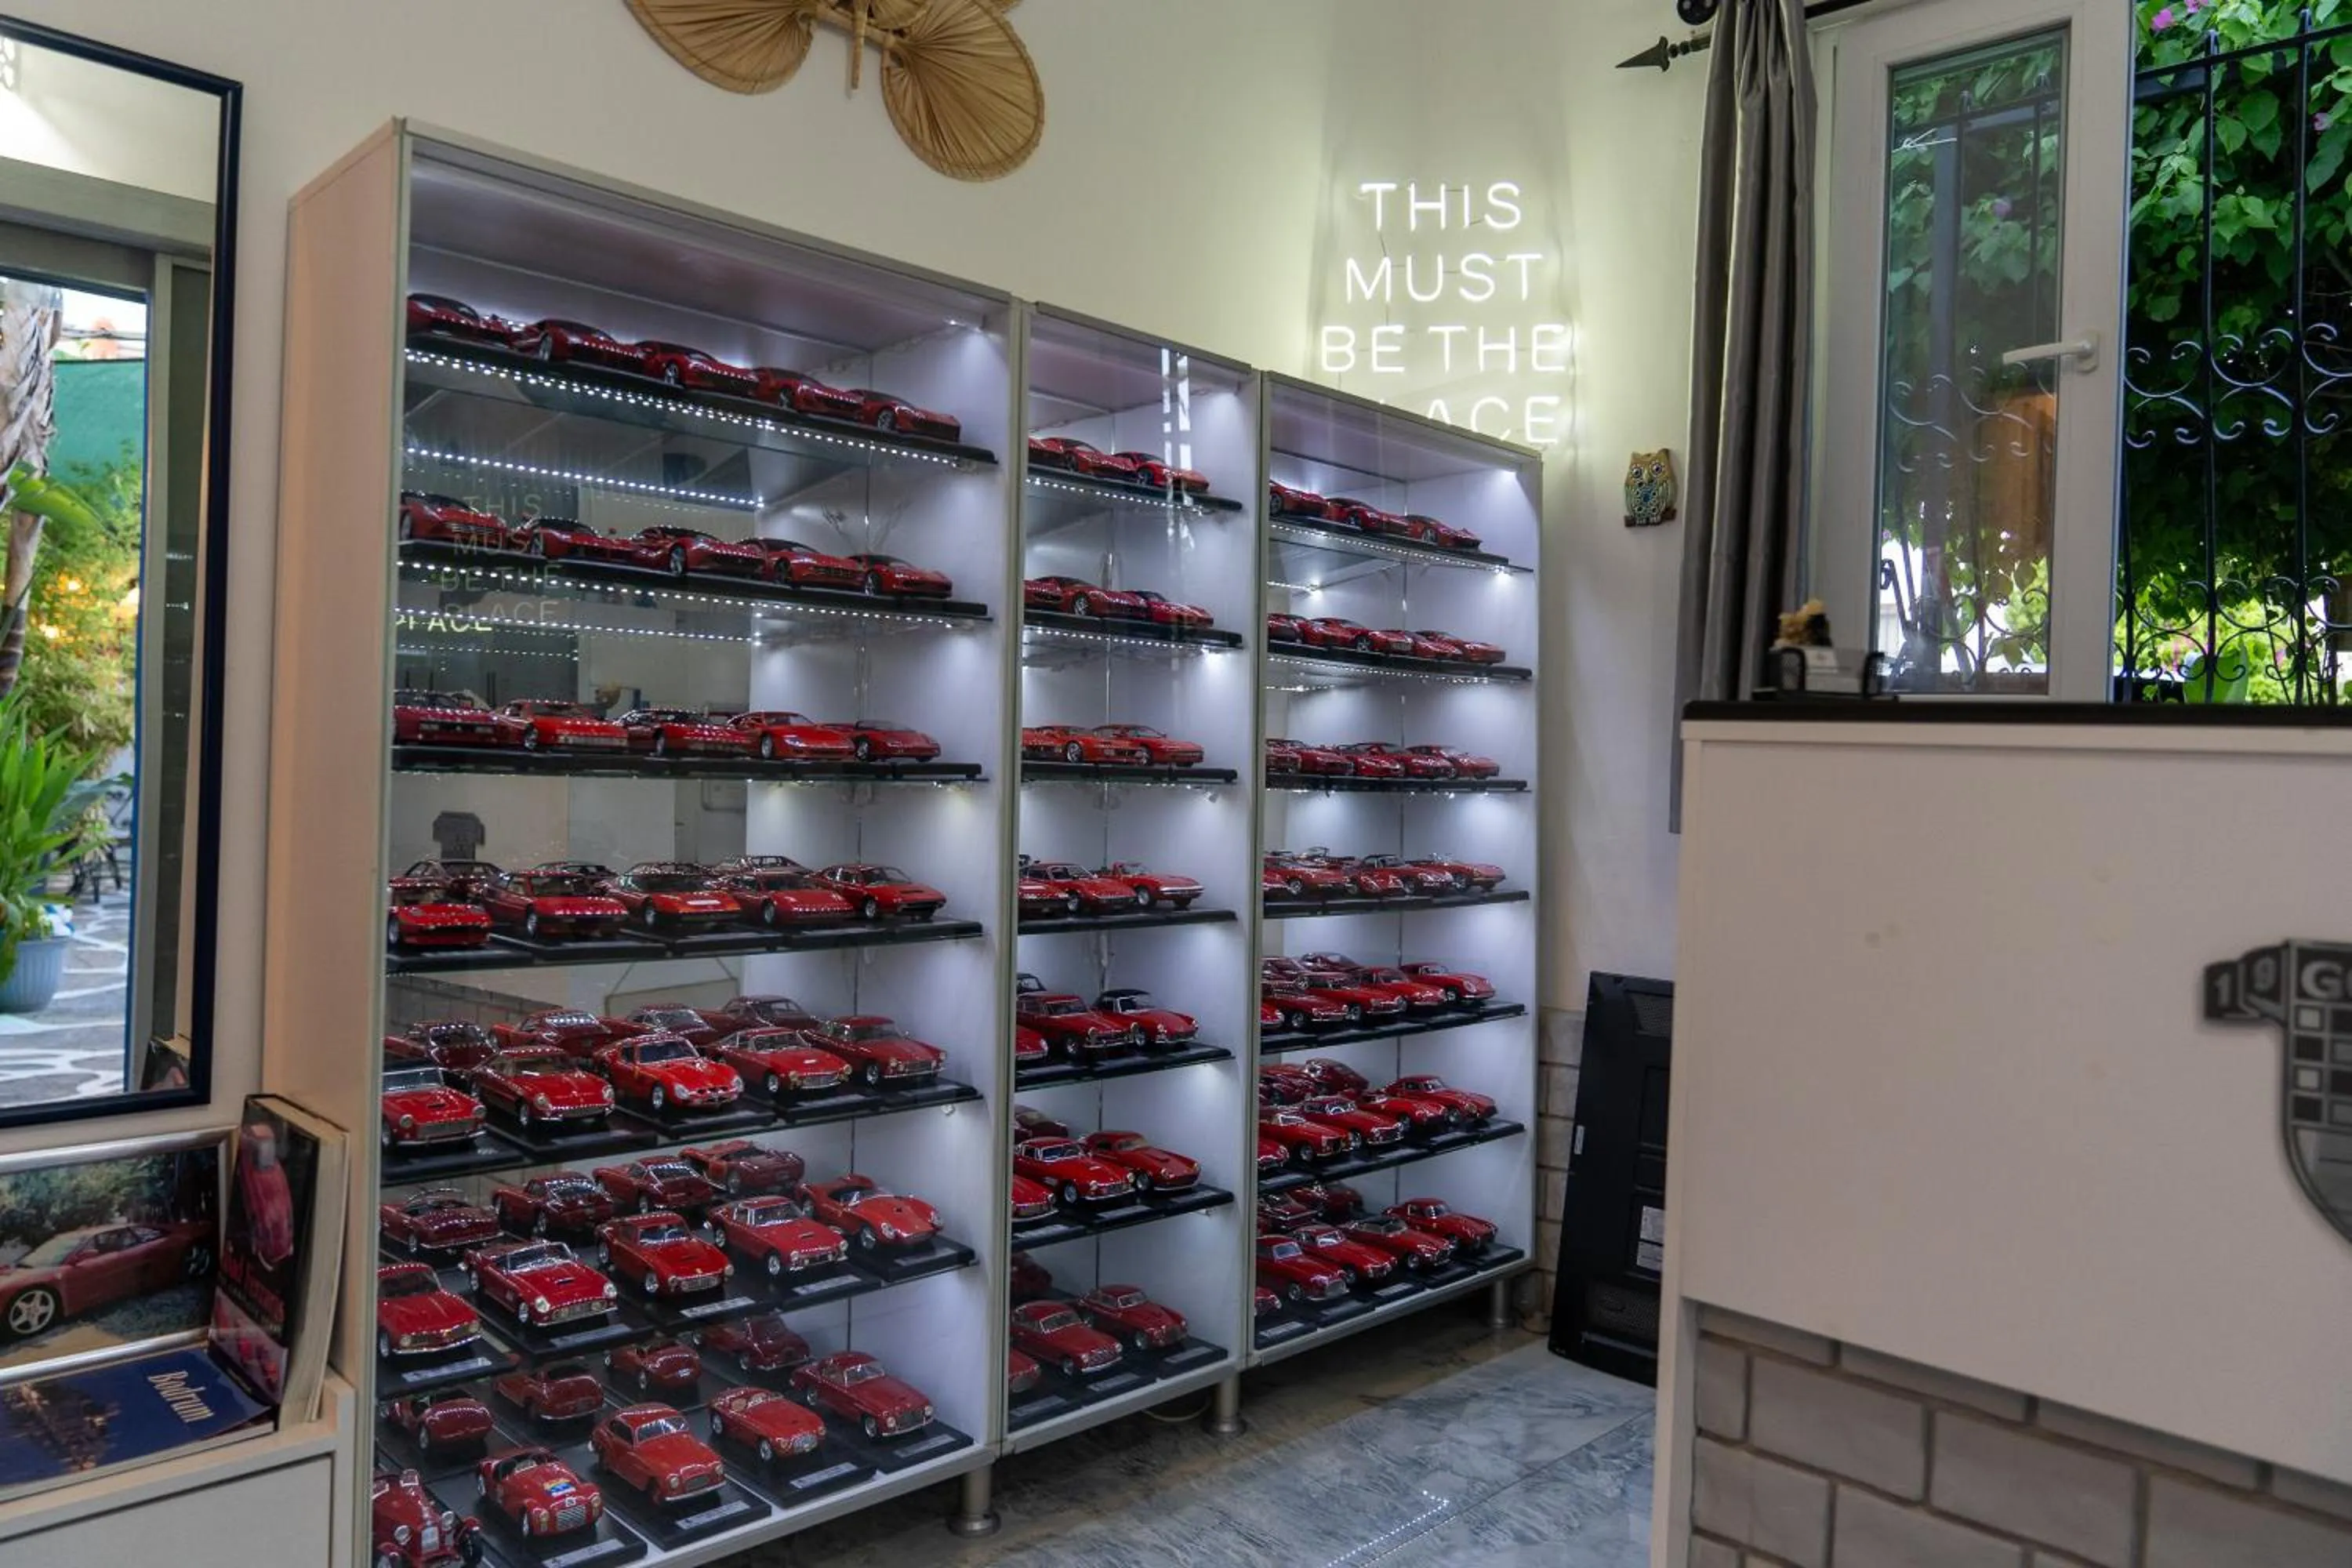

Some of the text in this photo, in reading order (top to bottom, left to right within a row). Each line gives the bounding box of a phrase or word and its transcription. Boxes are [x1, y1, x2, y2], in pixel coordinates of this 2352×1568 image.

[1359, 182, 1522, 231] THIS
[1345, 252, 1544, 303] MUST
[1320, 323, 1567, 375] BE THE
[1378, 396, 1561, 445] ACE
[463, 493, 543, 520] THIS
[2300, 960, 2352, 1000] G
[147, 1370, 215, 1423] Bodrum
